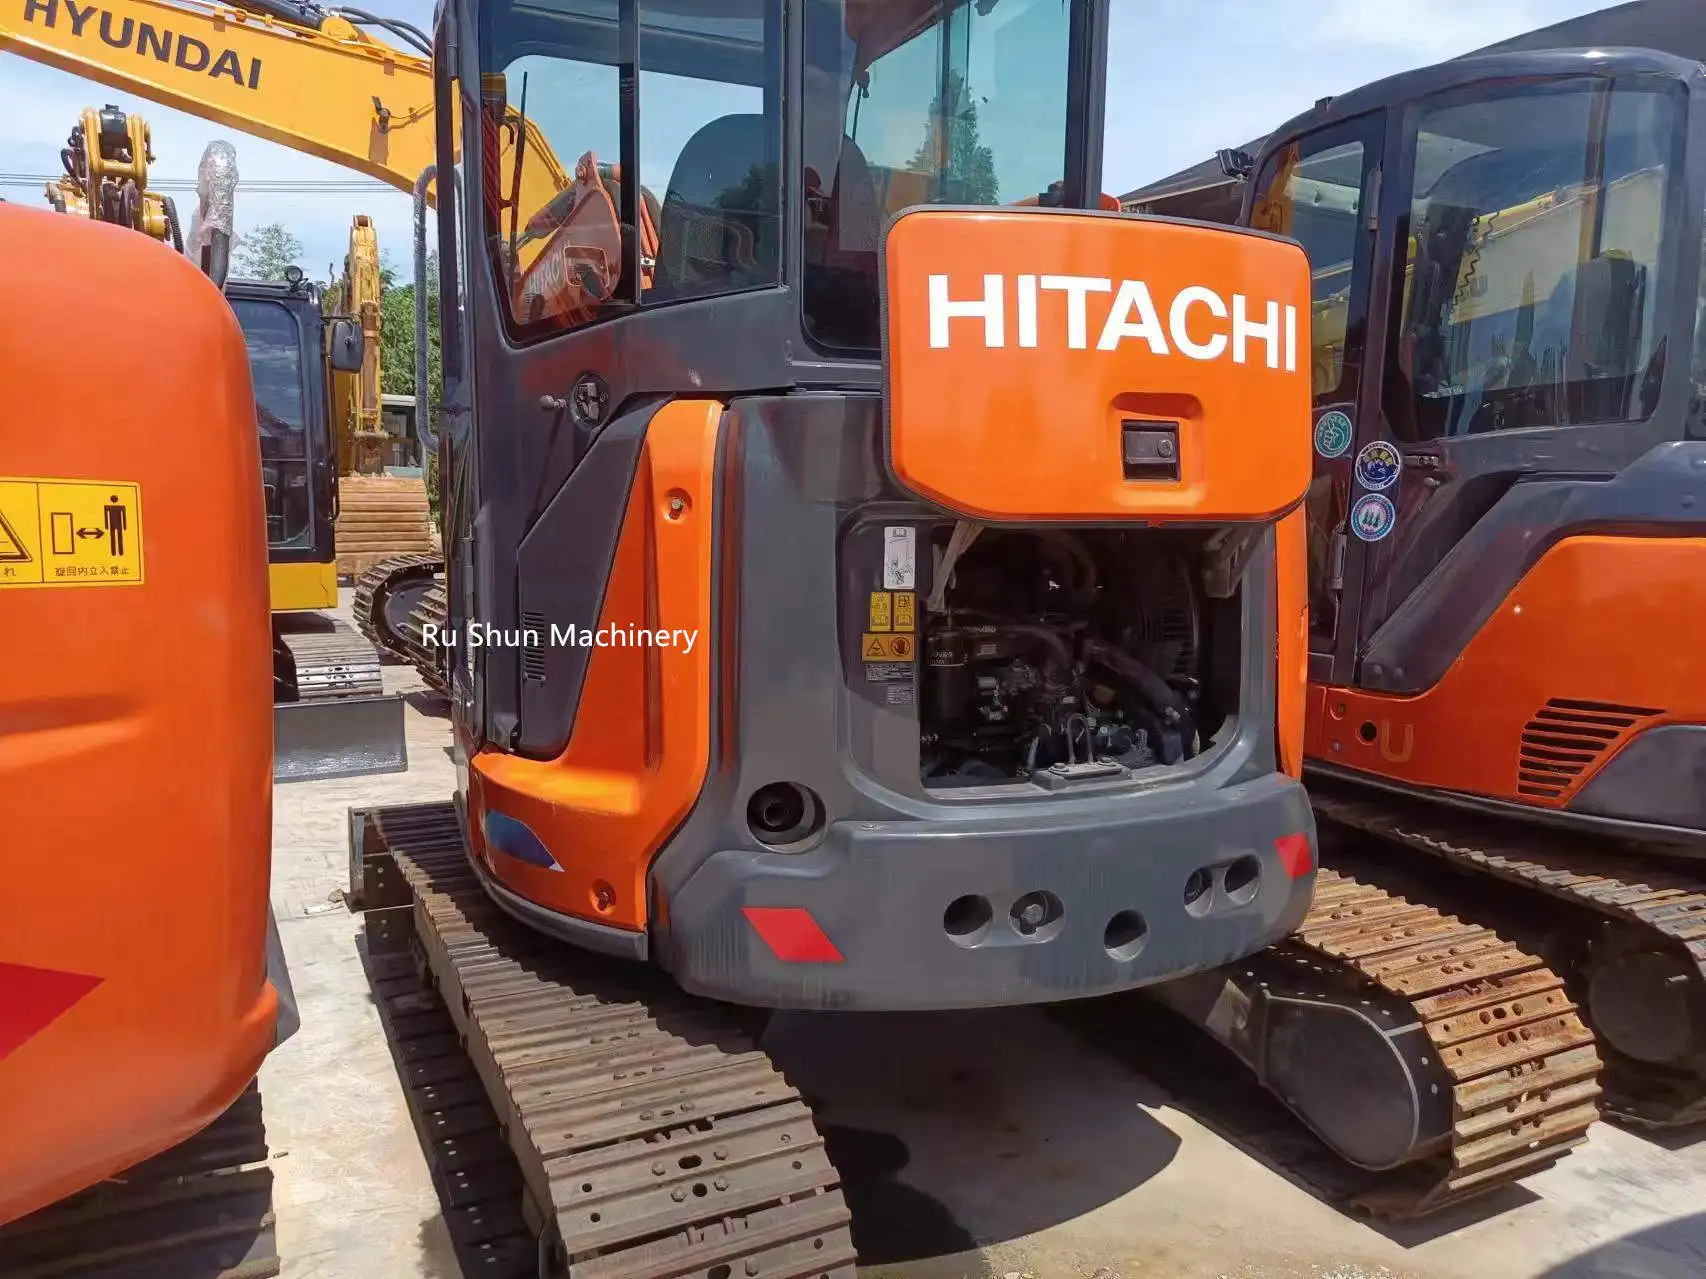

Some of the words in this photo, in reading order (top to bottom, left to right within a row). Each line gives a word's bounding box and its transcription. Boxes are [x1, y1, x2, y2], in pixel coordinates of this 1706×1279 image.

[24, 0, 263, 90] HYUNDAI
[928, 273, 1297, 372] HITACHI
[55, 566, 130, 577] 旋回内立入禁止
[1381, 718, 1414, 764] U
